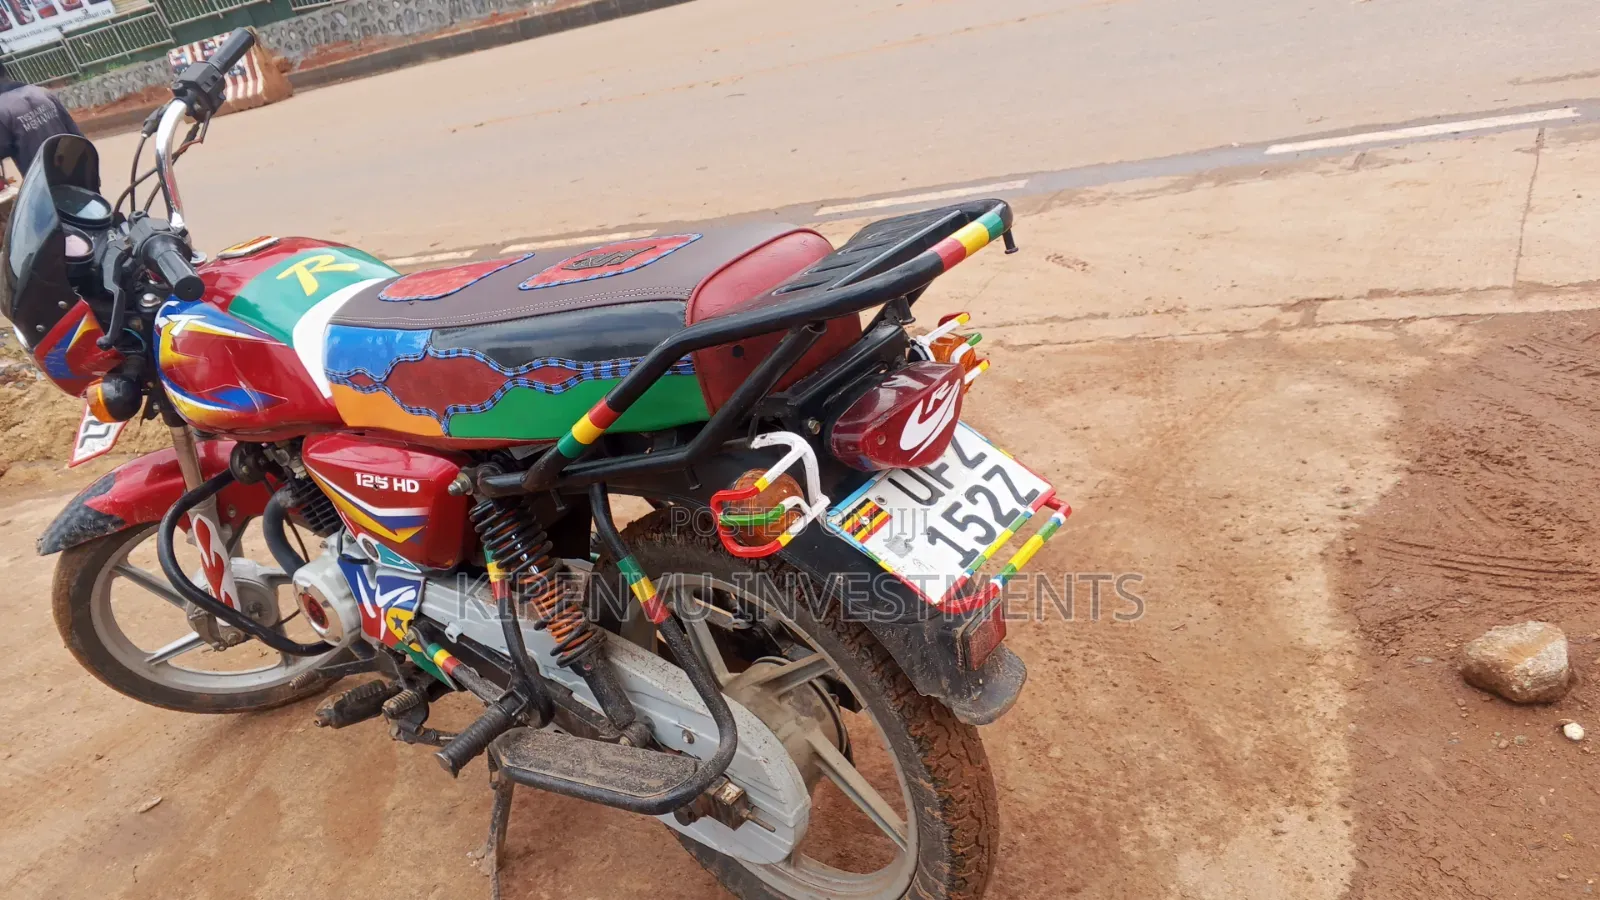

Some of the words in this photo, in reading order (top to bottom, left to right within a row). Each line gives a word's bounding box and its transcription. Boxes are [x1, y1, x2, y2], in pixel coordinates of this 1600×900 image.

[356, 473, 389, 490] 125
[392, 477, 419, 493] HD
[927, 464, 1039, 570] 152Z
